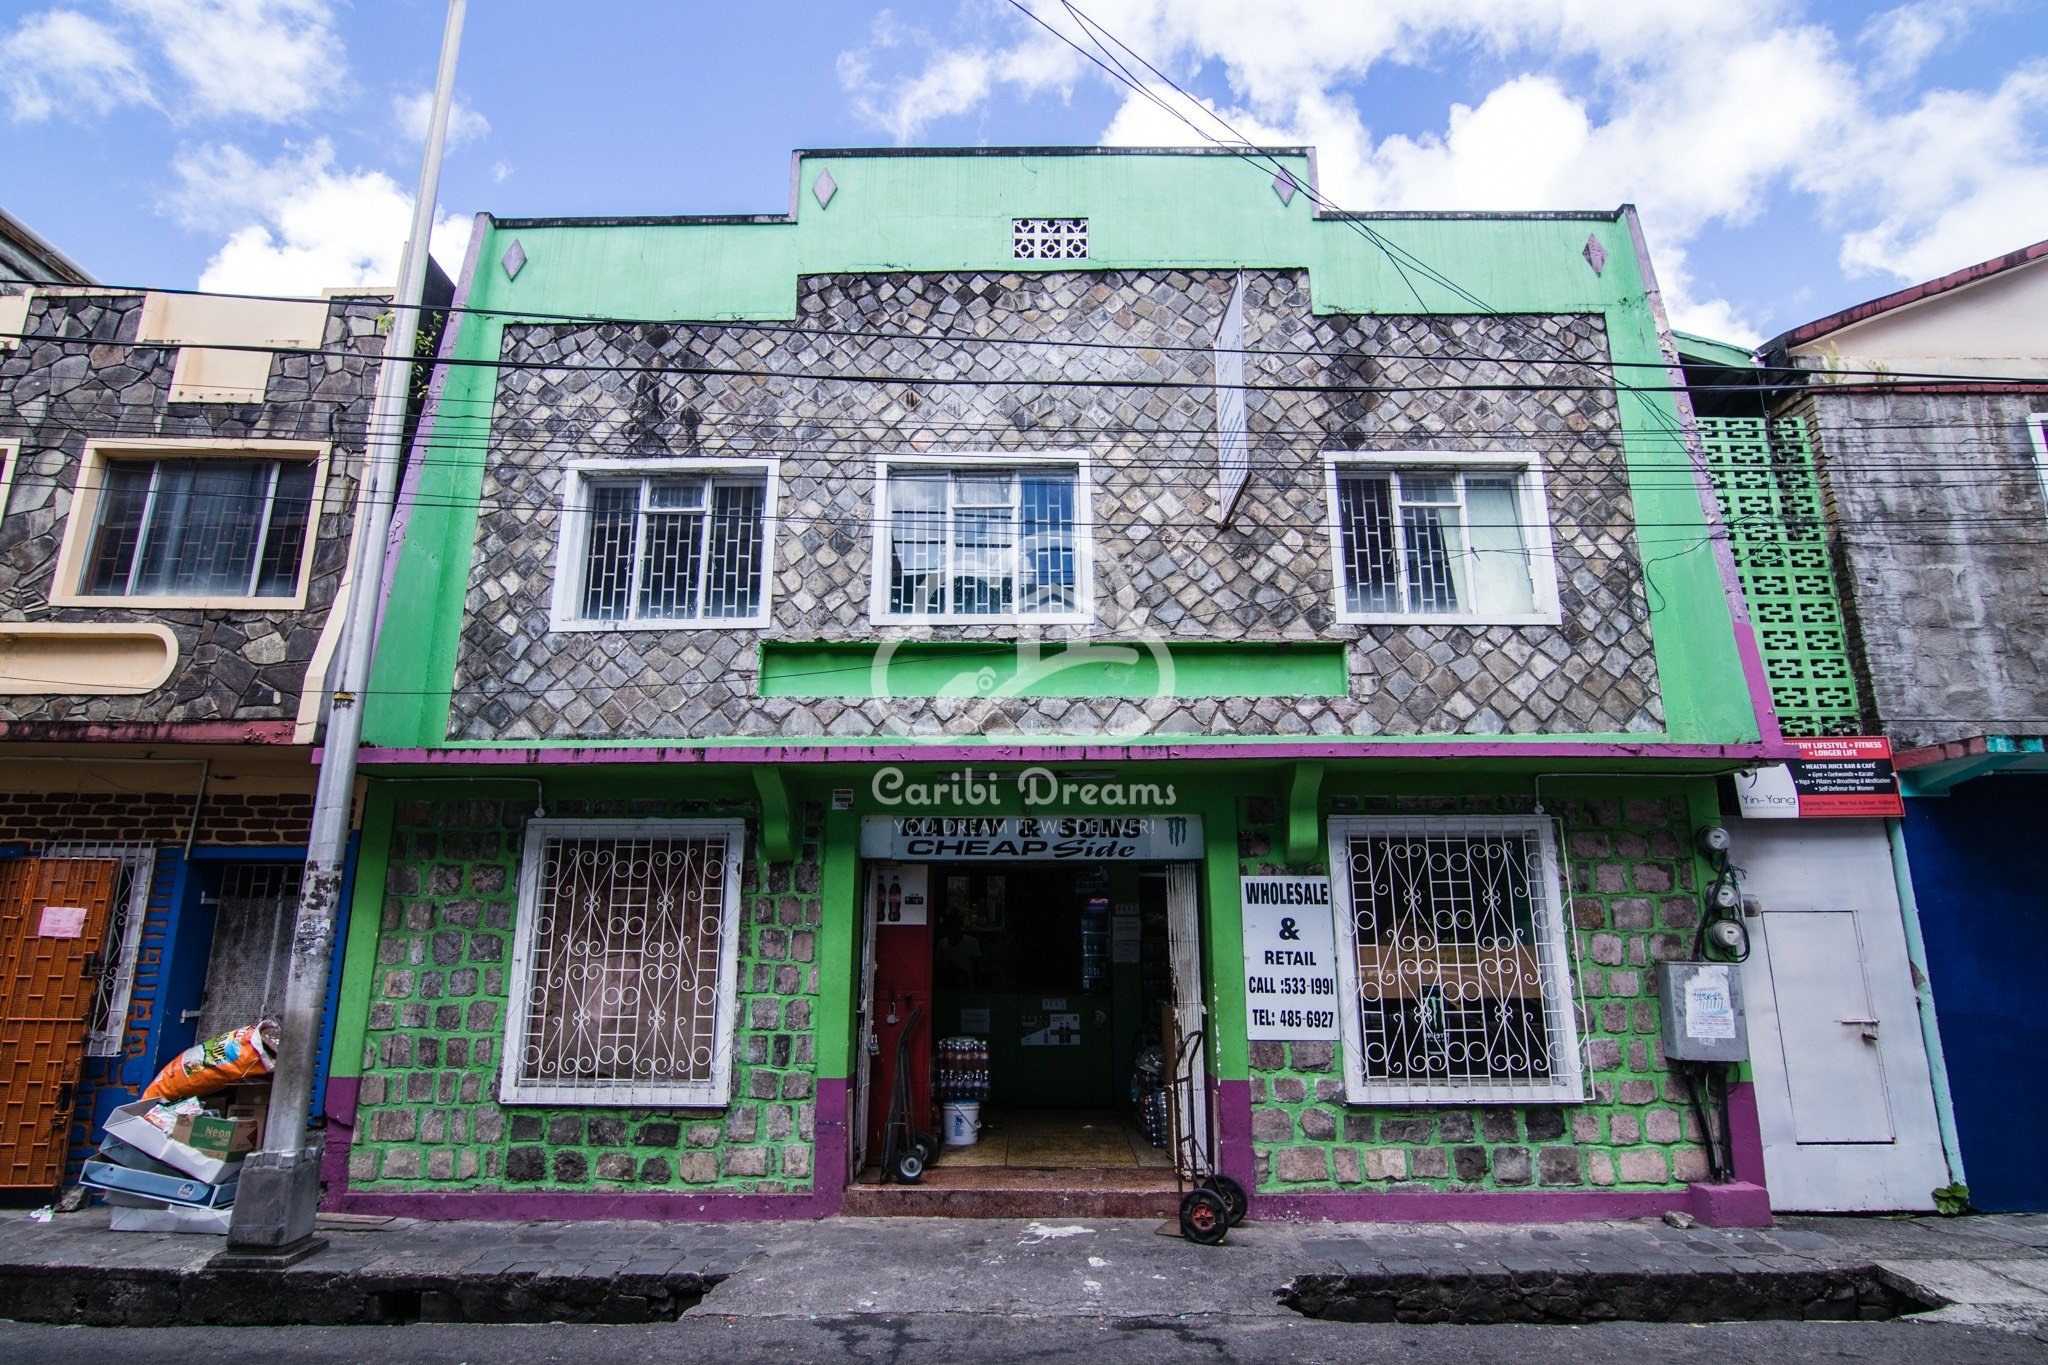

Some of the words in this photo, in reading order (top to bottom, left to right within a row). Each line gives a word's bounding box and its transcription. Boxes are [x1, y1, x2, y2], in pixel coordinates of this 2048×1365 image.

[1814, 749, 1842, 757] LONGER
[1843, 749, 1858, 757] LIFE
[1854, 741, 1882, 749] FITNESS
[1861, 761, 1876, 769] CAFÉ
[1741, 794, 1796, 806] Yin-Yang
[1018, 817, 1041, 838] &
[1058, 817, 1141, 838] SONS
[907, 839, 1048, 856] CHEAP
[1052, 839, 1136, 858] Side
[1246, 882, 1328, 905] WHOLESALE
[1279, 917, 1300, 940] &
[1264, 950, 1316, 966] RETAIL
[1249, 976, 1276, 994] CALL
[1252, 1009, 1275, 1026] TEL:
[1280, 1010, 1334, 1028] 485-6927
[205, 1126, 231, 1139] Neon
